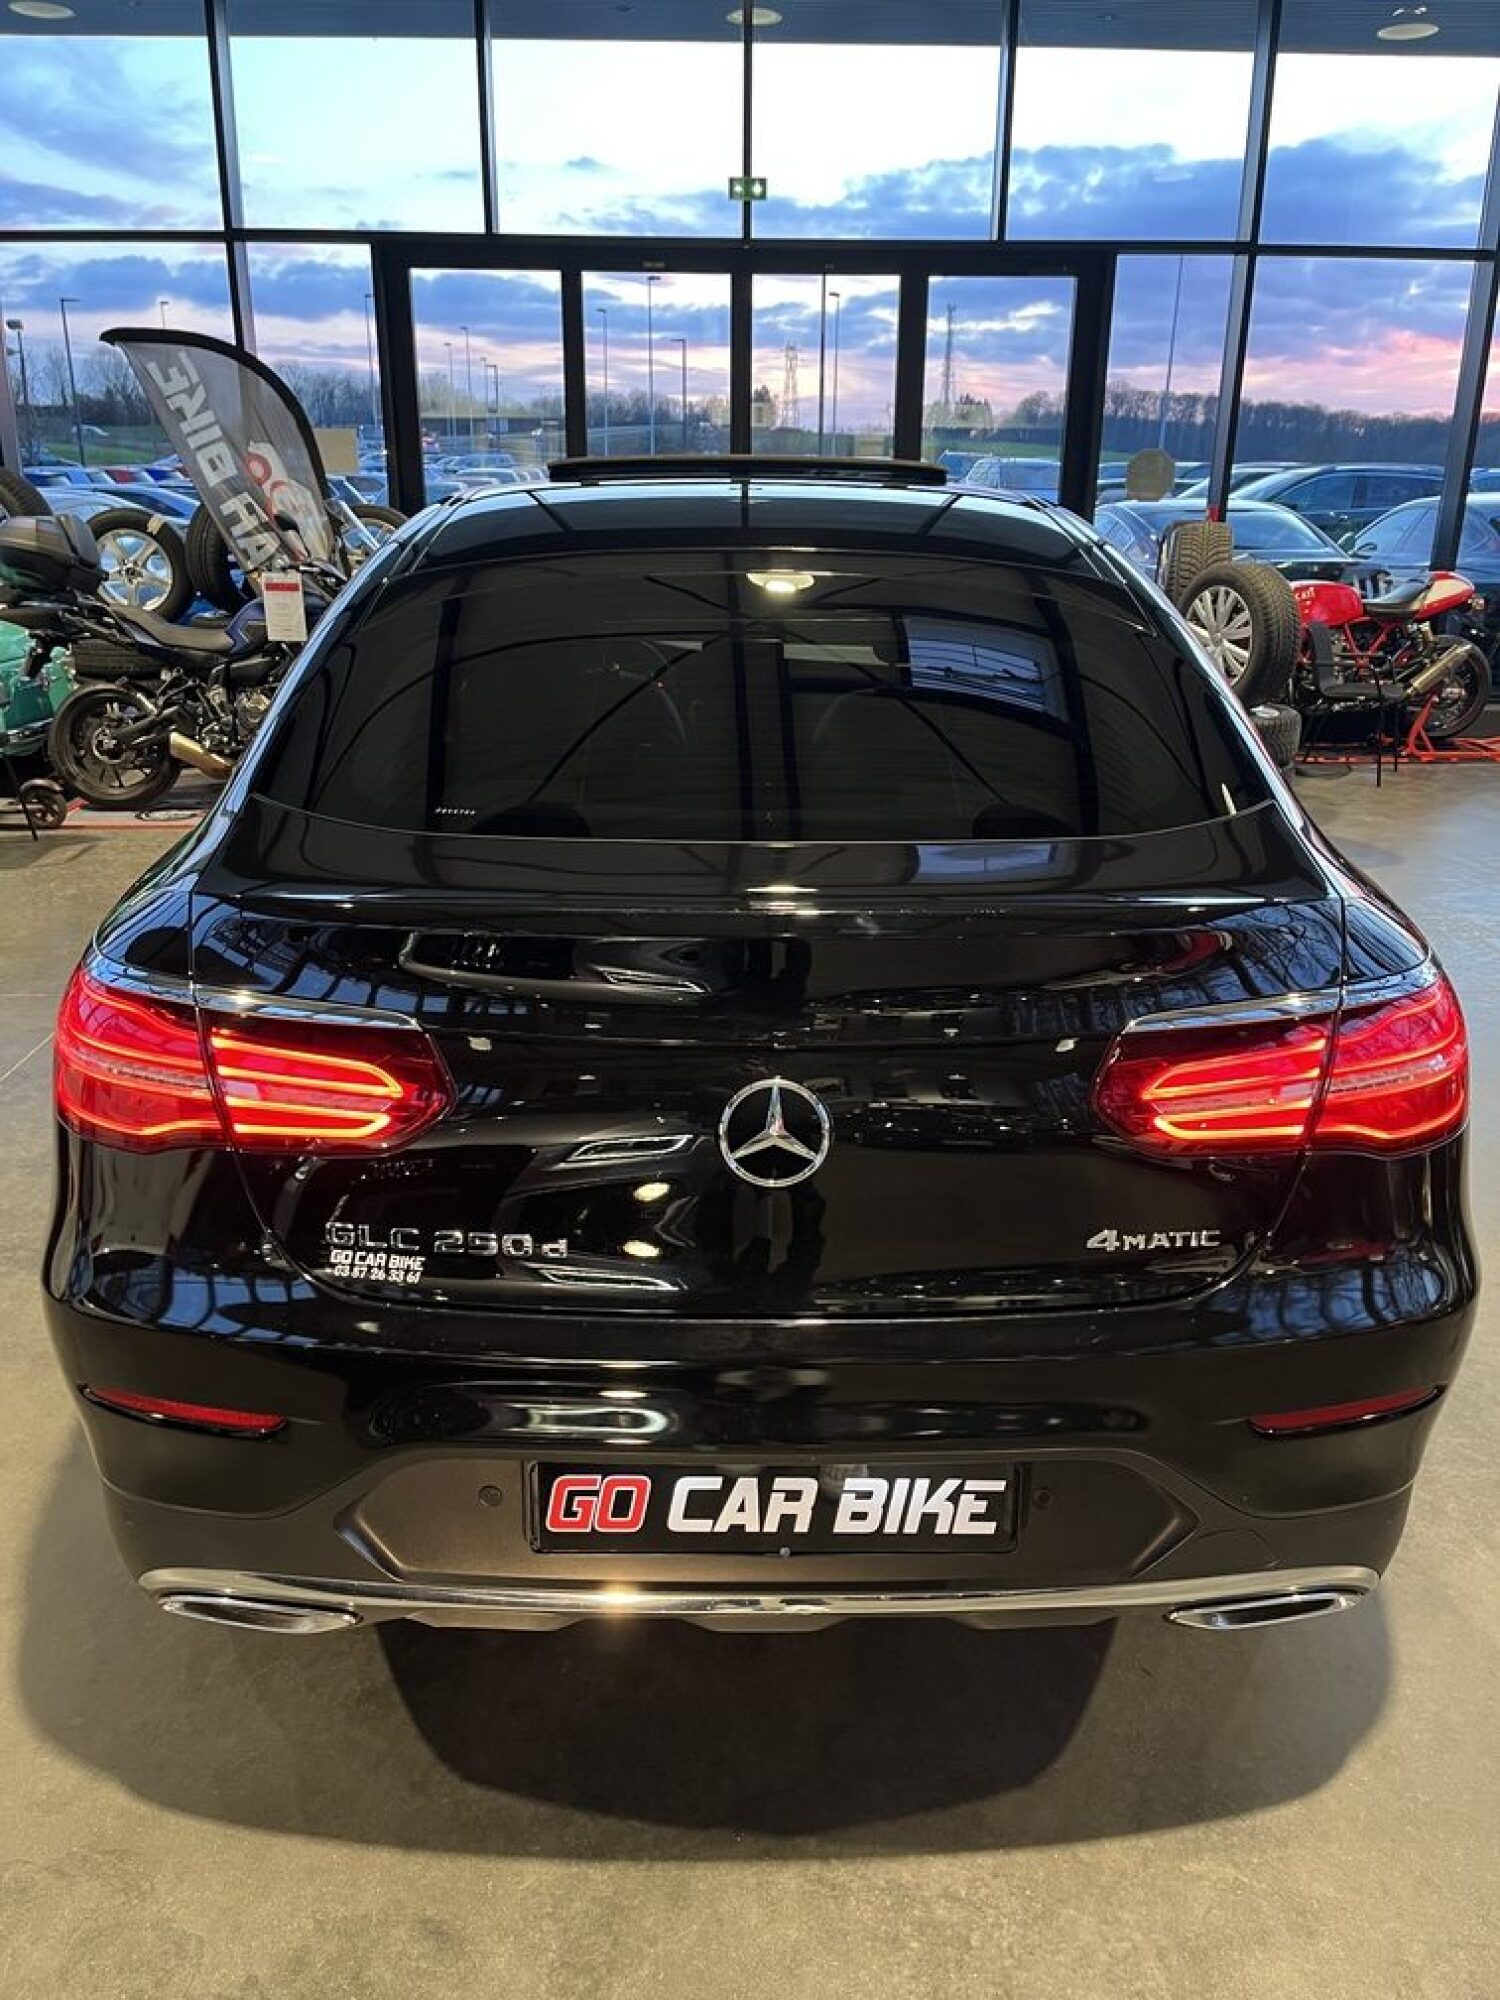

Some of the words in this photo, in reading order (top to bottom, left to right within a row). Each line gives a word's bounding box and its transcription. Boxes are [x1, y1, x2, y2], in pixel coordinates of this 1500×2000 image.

[325, 1221, 420, 1251] GLC
[434, 1230, 534, 1257] 250
[541, 1238, 568, 1258] d
[1086, 1229, 1221, 1252] 4MATIC
[330, 1249, 353, 1263] GO
[355, 1251, 387, 1267] CAR
[389, 1254, 426, 1271] BIKE
[544, 1474, 651, 1534] GO
[667, 1475, 819, 1534] CAR
[833, 1477, 1007, 1535] BIKE
